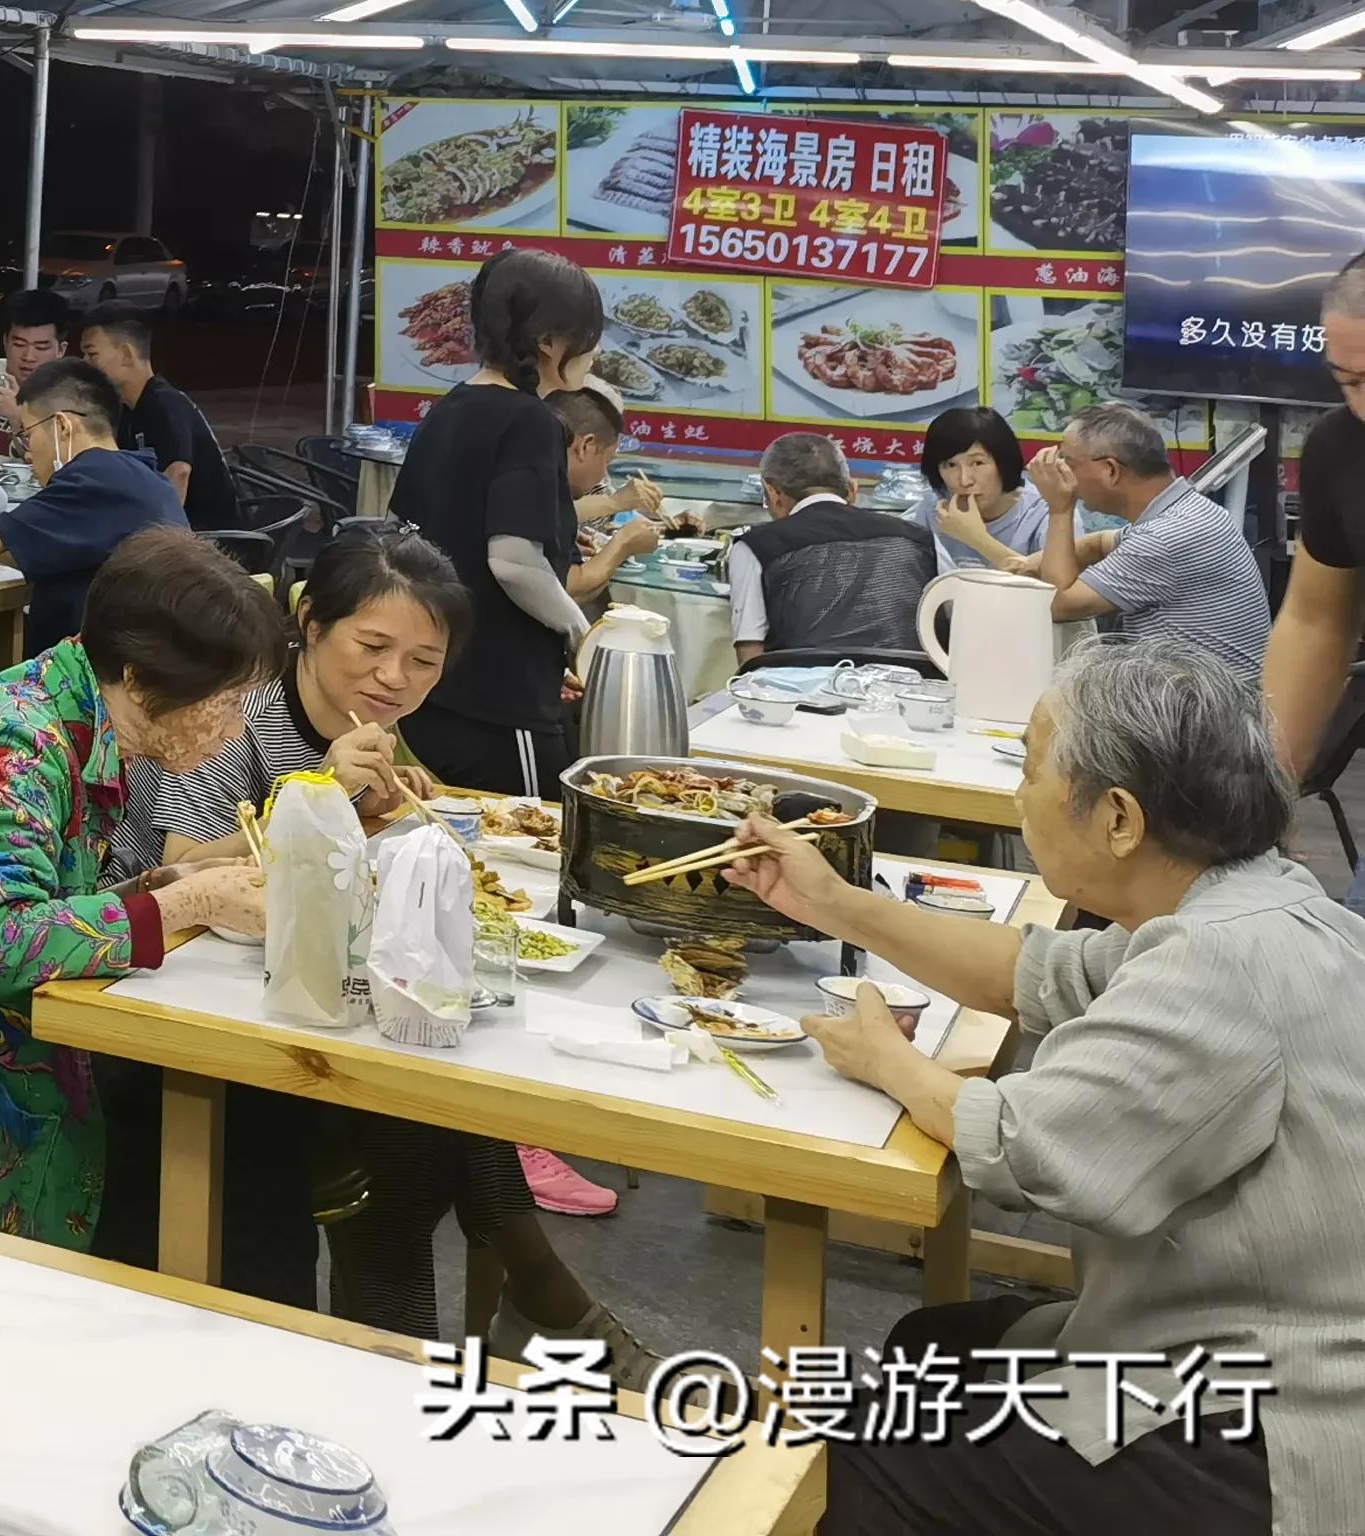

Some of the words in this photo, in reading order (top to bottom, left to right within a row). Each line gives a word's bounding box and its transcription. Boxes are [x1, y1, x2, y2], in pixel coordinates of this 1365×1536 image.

[687, 121, 856, 193] 精装海景房
[870, 140, 936, 197] 日租
[682, 185, 798, 228] 4室3卫
[809, 197, 929, 241] 4室4卫
[608, 244, 668, 266] 清蒸
[679, 222, 929, 278] 15650137177
[1179, 316, 1329, 353] 多久没有好
